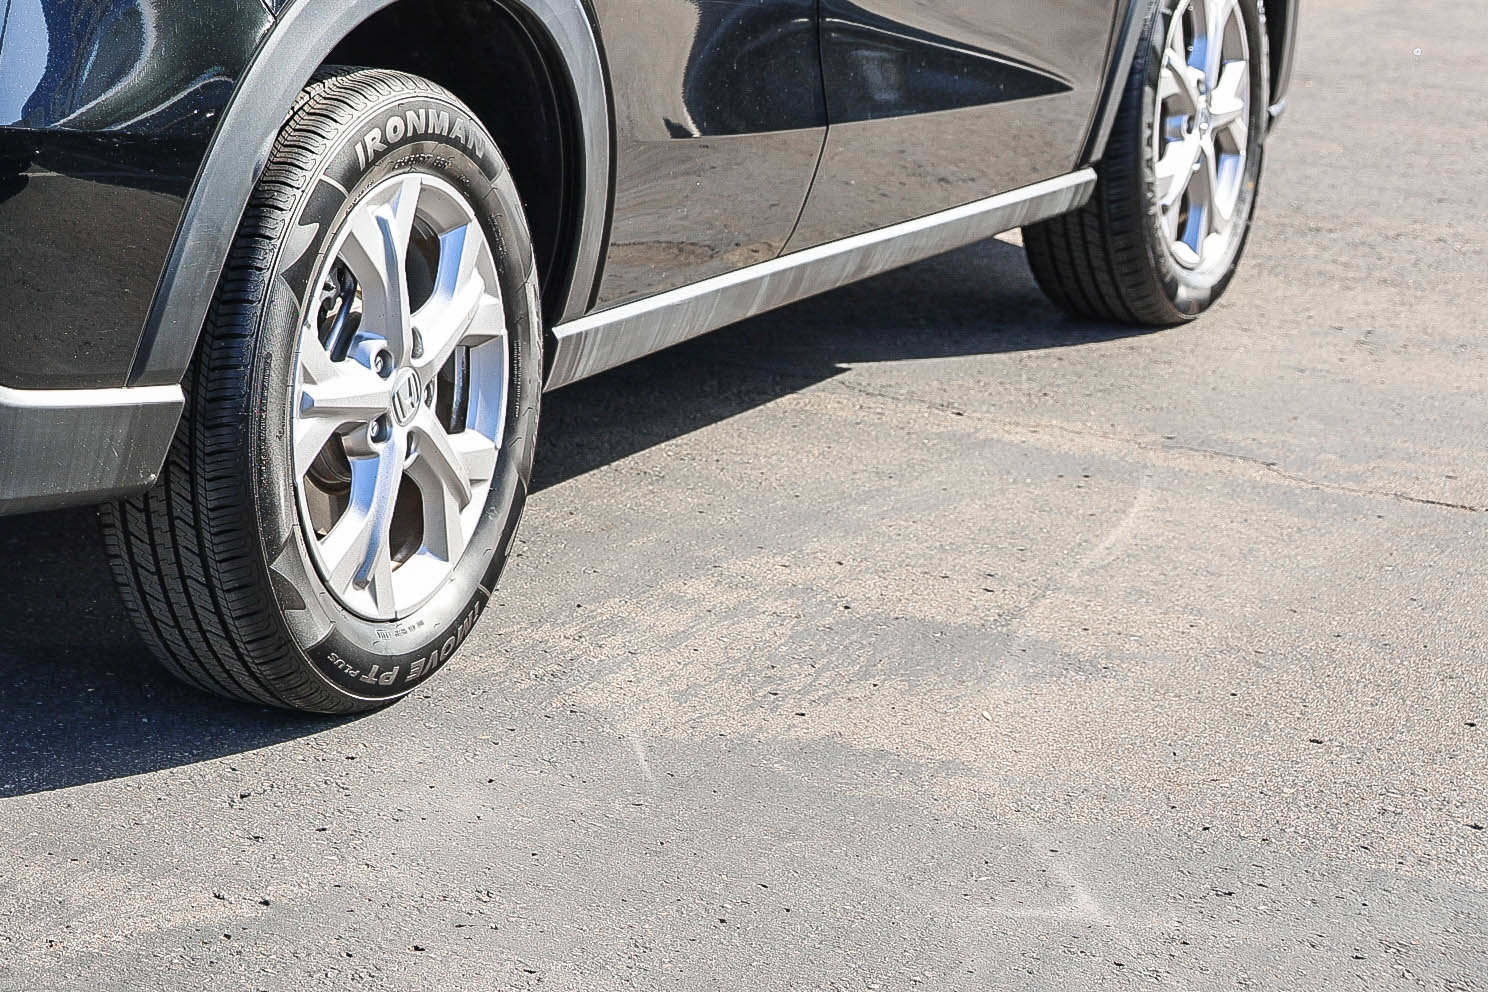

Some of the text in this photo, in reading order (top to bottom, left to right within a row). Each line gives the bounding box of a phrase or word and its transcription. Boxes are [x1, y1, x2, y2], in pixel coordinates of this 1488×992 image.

[354, 108, 486, 171] IRONMAN
[327, 652, 360, 678] PLUS
[360, 664, 400, 686] PT
